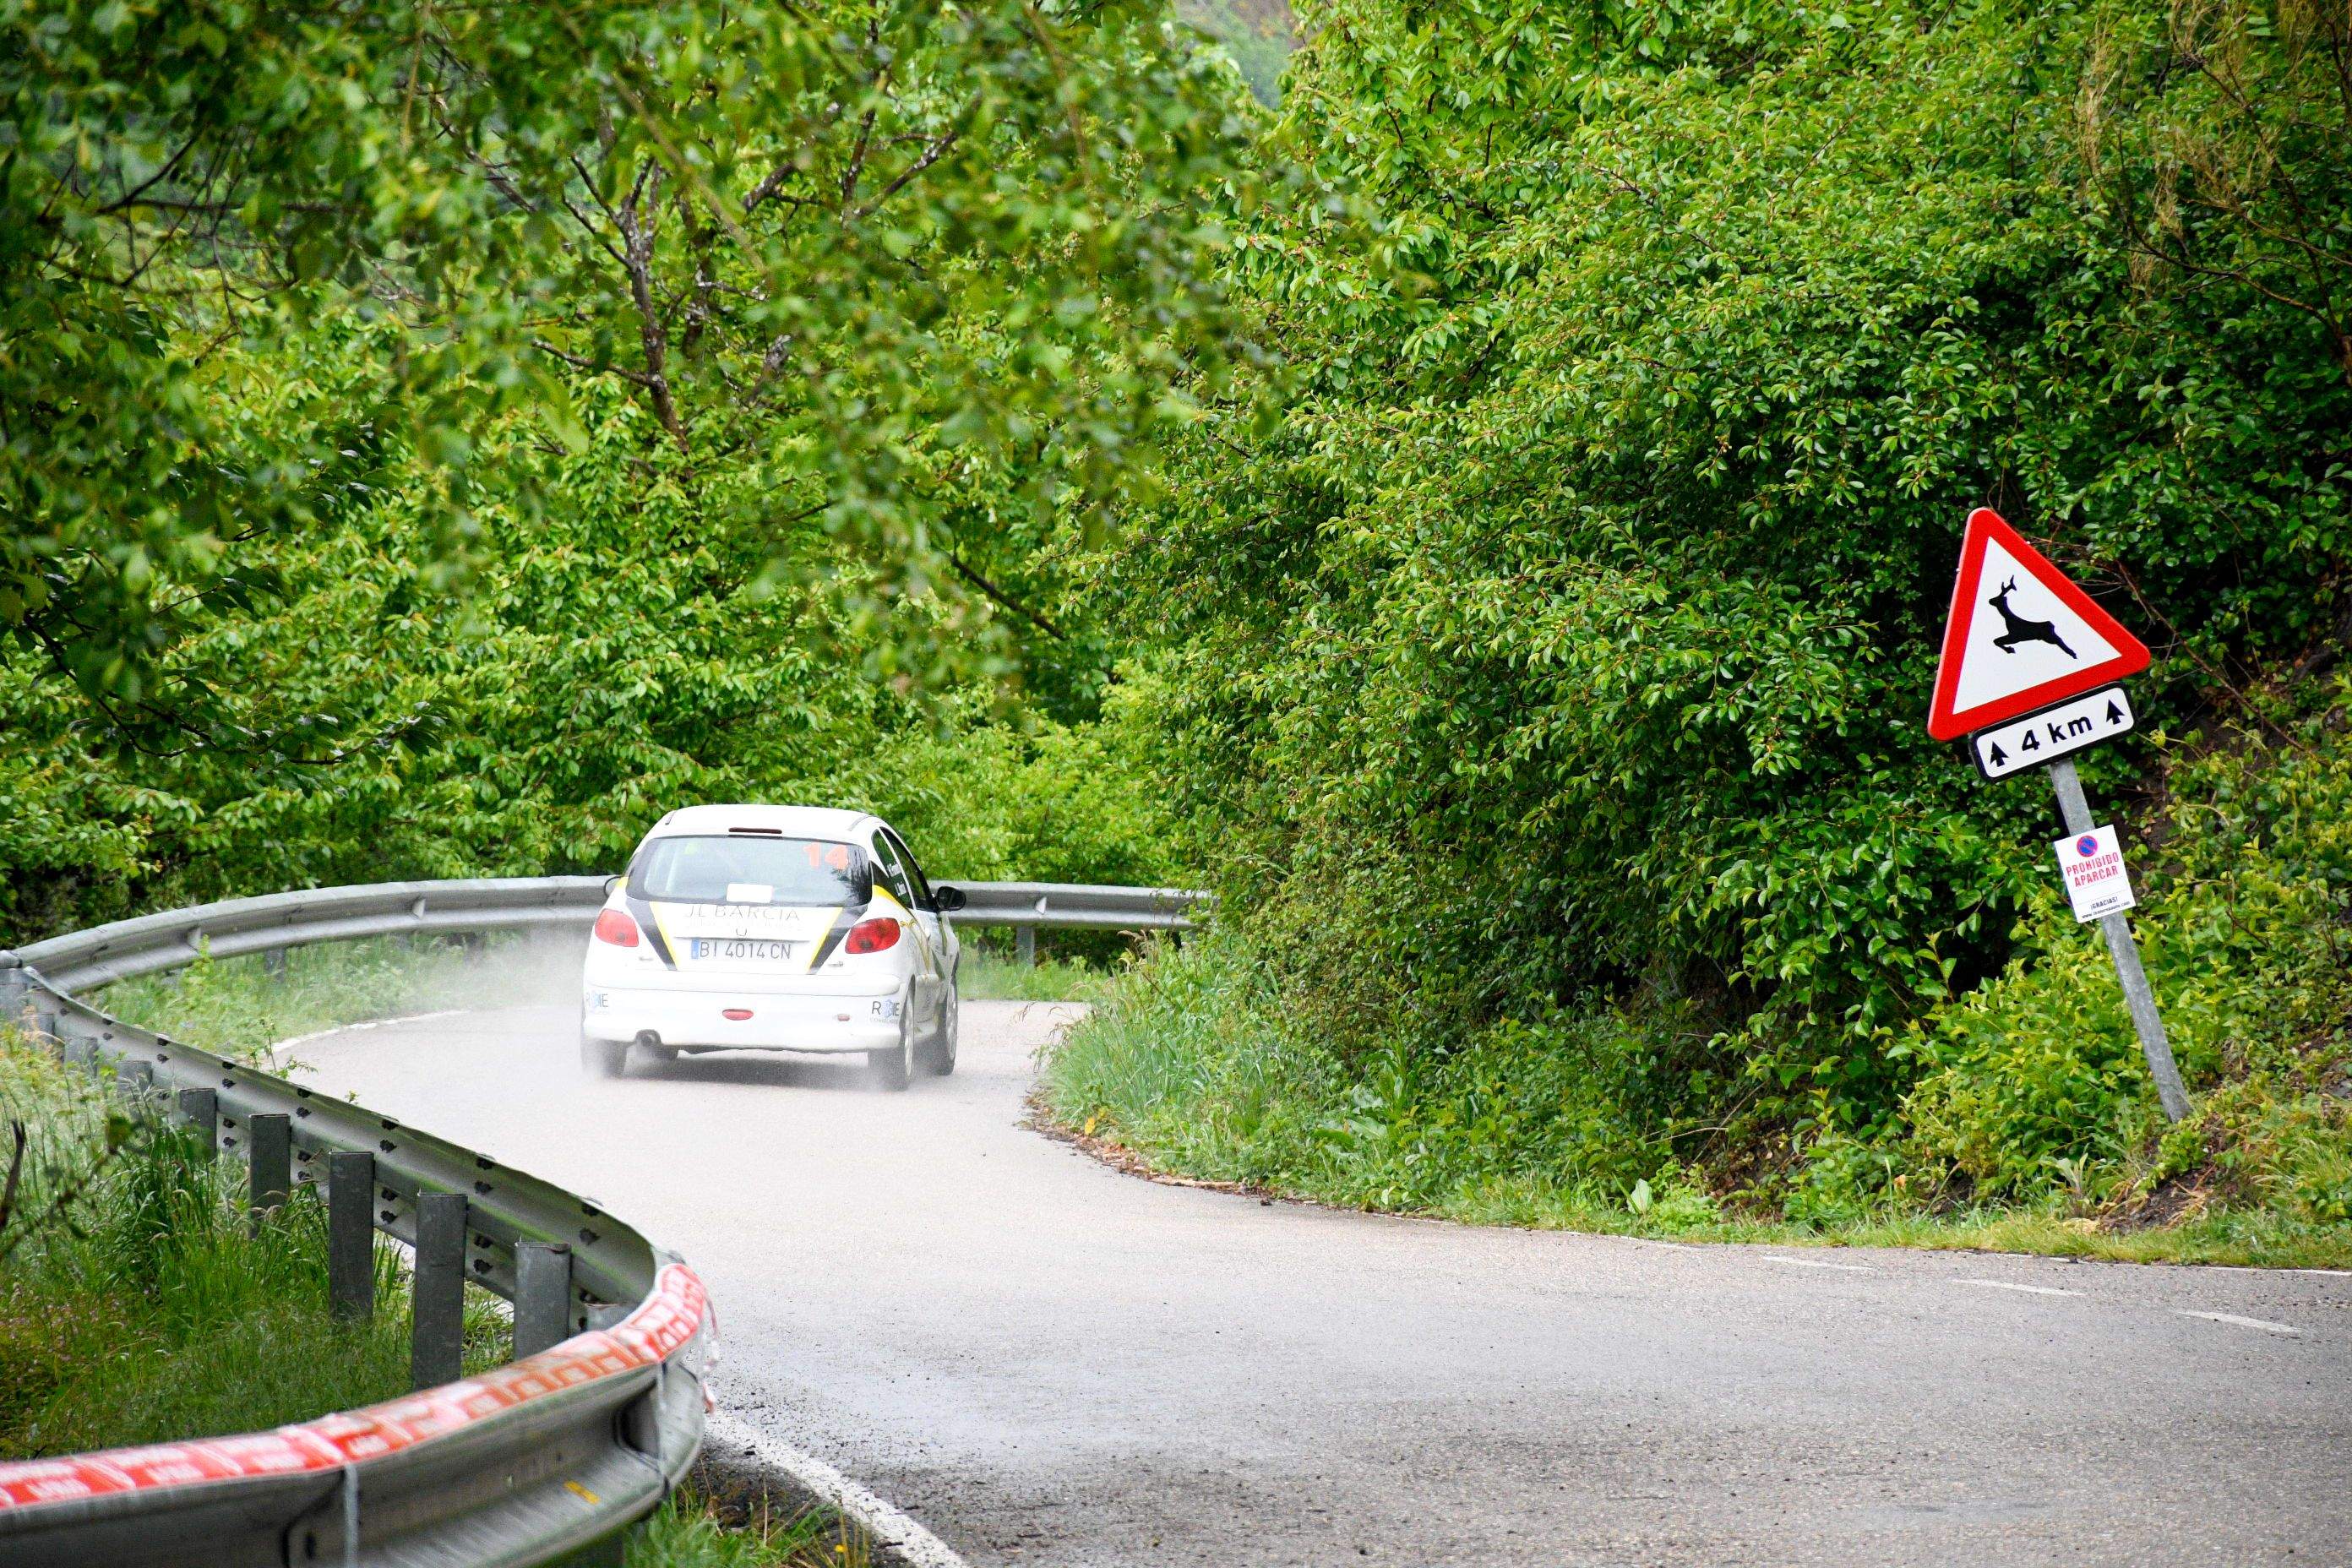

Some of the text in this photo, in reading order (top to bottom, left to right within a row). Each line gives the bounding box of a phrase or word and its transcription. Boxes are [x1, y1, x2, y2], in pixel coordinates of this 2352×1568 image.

[2022, 716, 2093, 751] 4 km
[803, 841, 848, 870] 14
[2066, 852, 2119, 876] PROHIBIDO
[2074, 865, 2119, 887] APARCAR
[700, 941, 792, 960] BI 4014 CN
